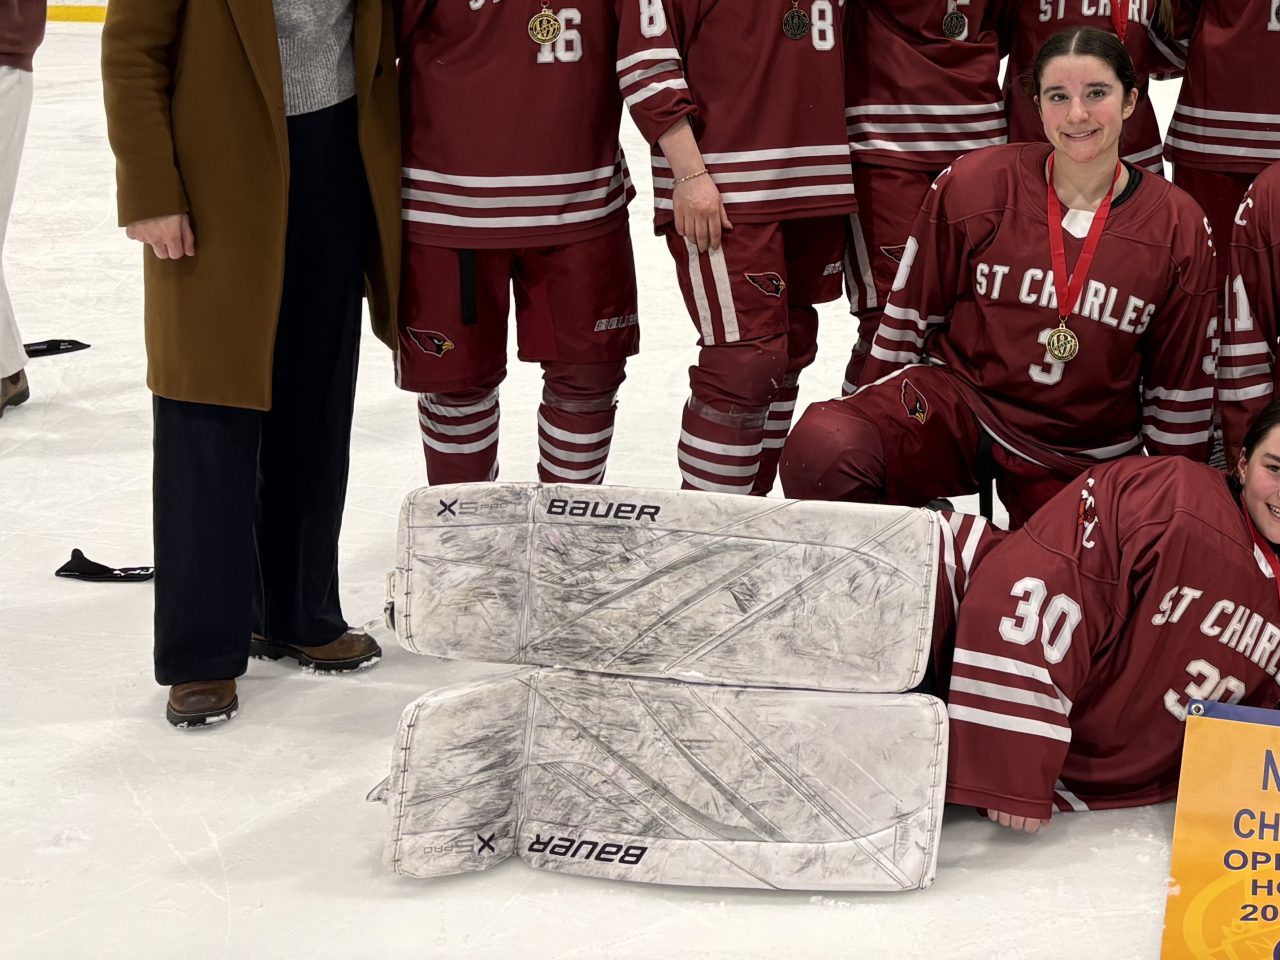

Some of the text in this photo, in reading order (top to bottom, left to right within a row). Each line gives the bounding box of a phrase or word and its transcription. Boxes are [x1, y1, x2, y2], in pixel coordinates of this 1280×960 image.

[811, 0, 835, 51] 8
[976, 262, 1010, 300] ST
[1019, 268, 1156, 335] CHRLES
[998, 576, 1082, 664] 30
[1151, 585, 1204, 626] ST
[1163, 659, 1246, 722] 30
